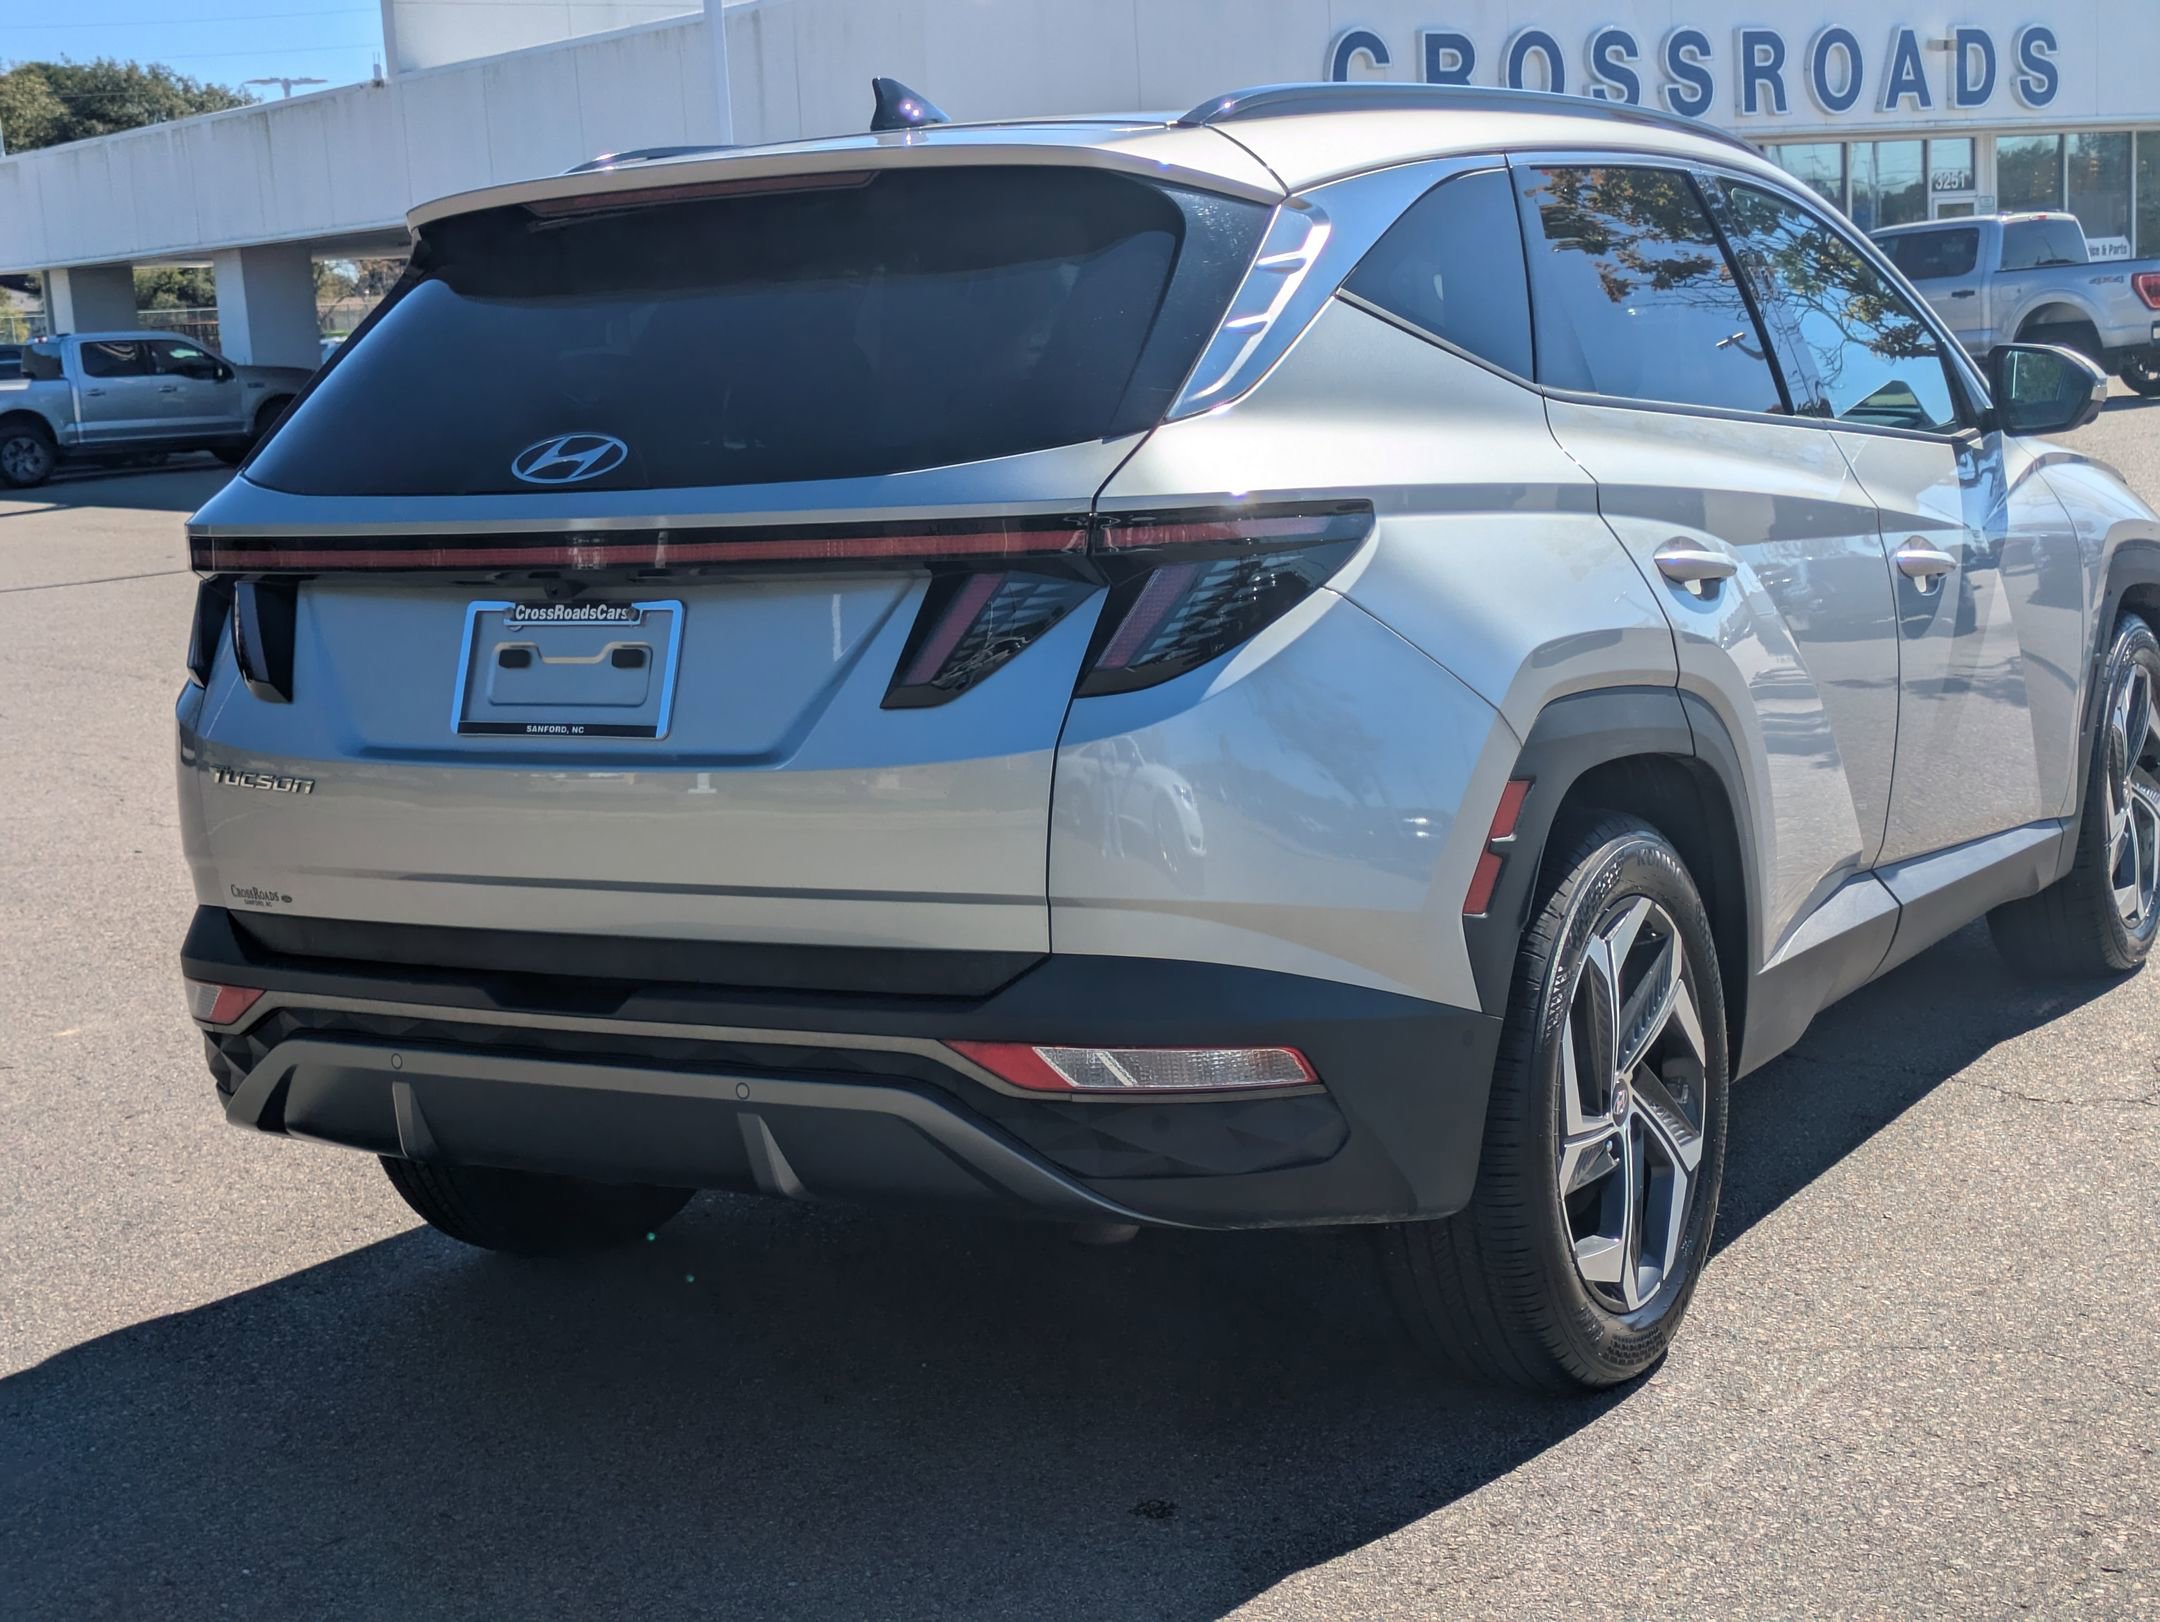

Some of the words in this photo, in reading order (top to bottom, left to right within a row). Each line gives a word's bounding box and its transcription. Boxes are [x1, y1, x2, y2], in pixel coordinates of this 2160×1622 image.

[1325, 25, 2060, 119] CROSSROADS
[1935, 171, 1965, 190] 3251
[515, 604, 628, 620] CrossRoadsCars
[526, 725, 569, 734] SANFORD,
[572, 726, 585, 734] NC
